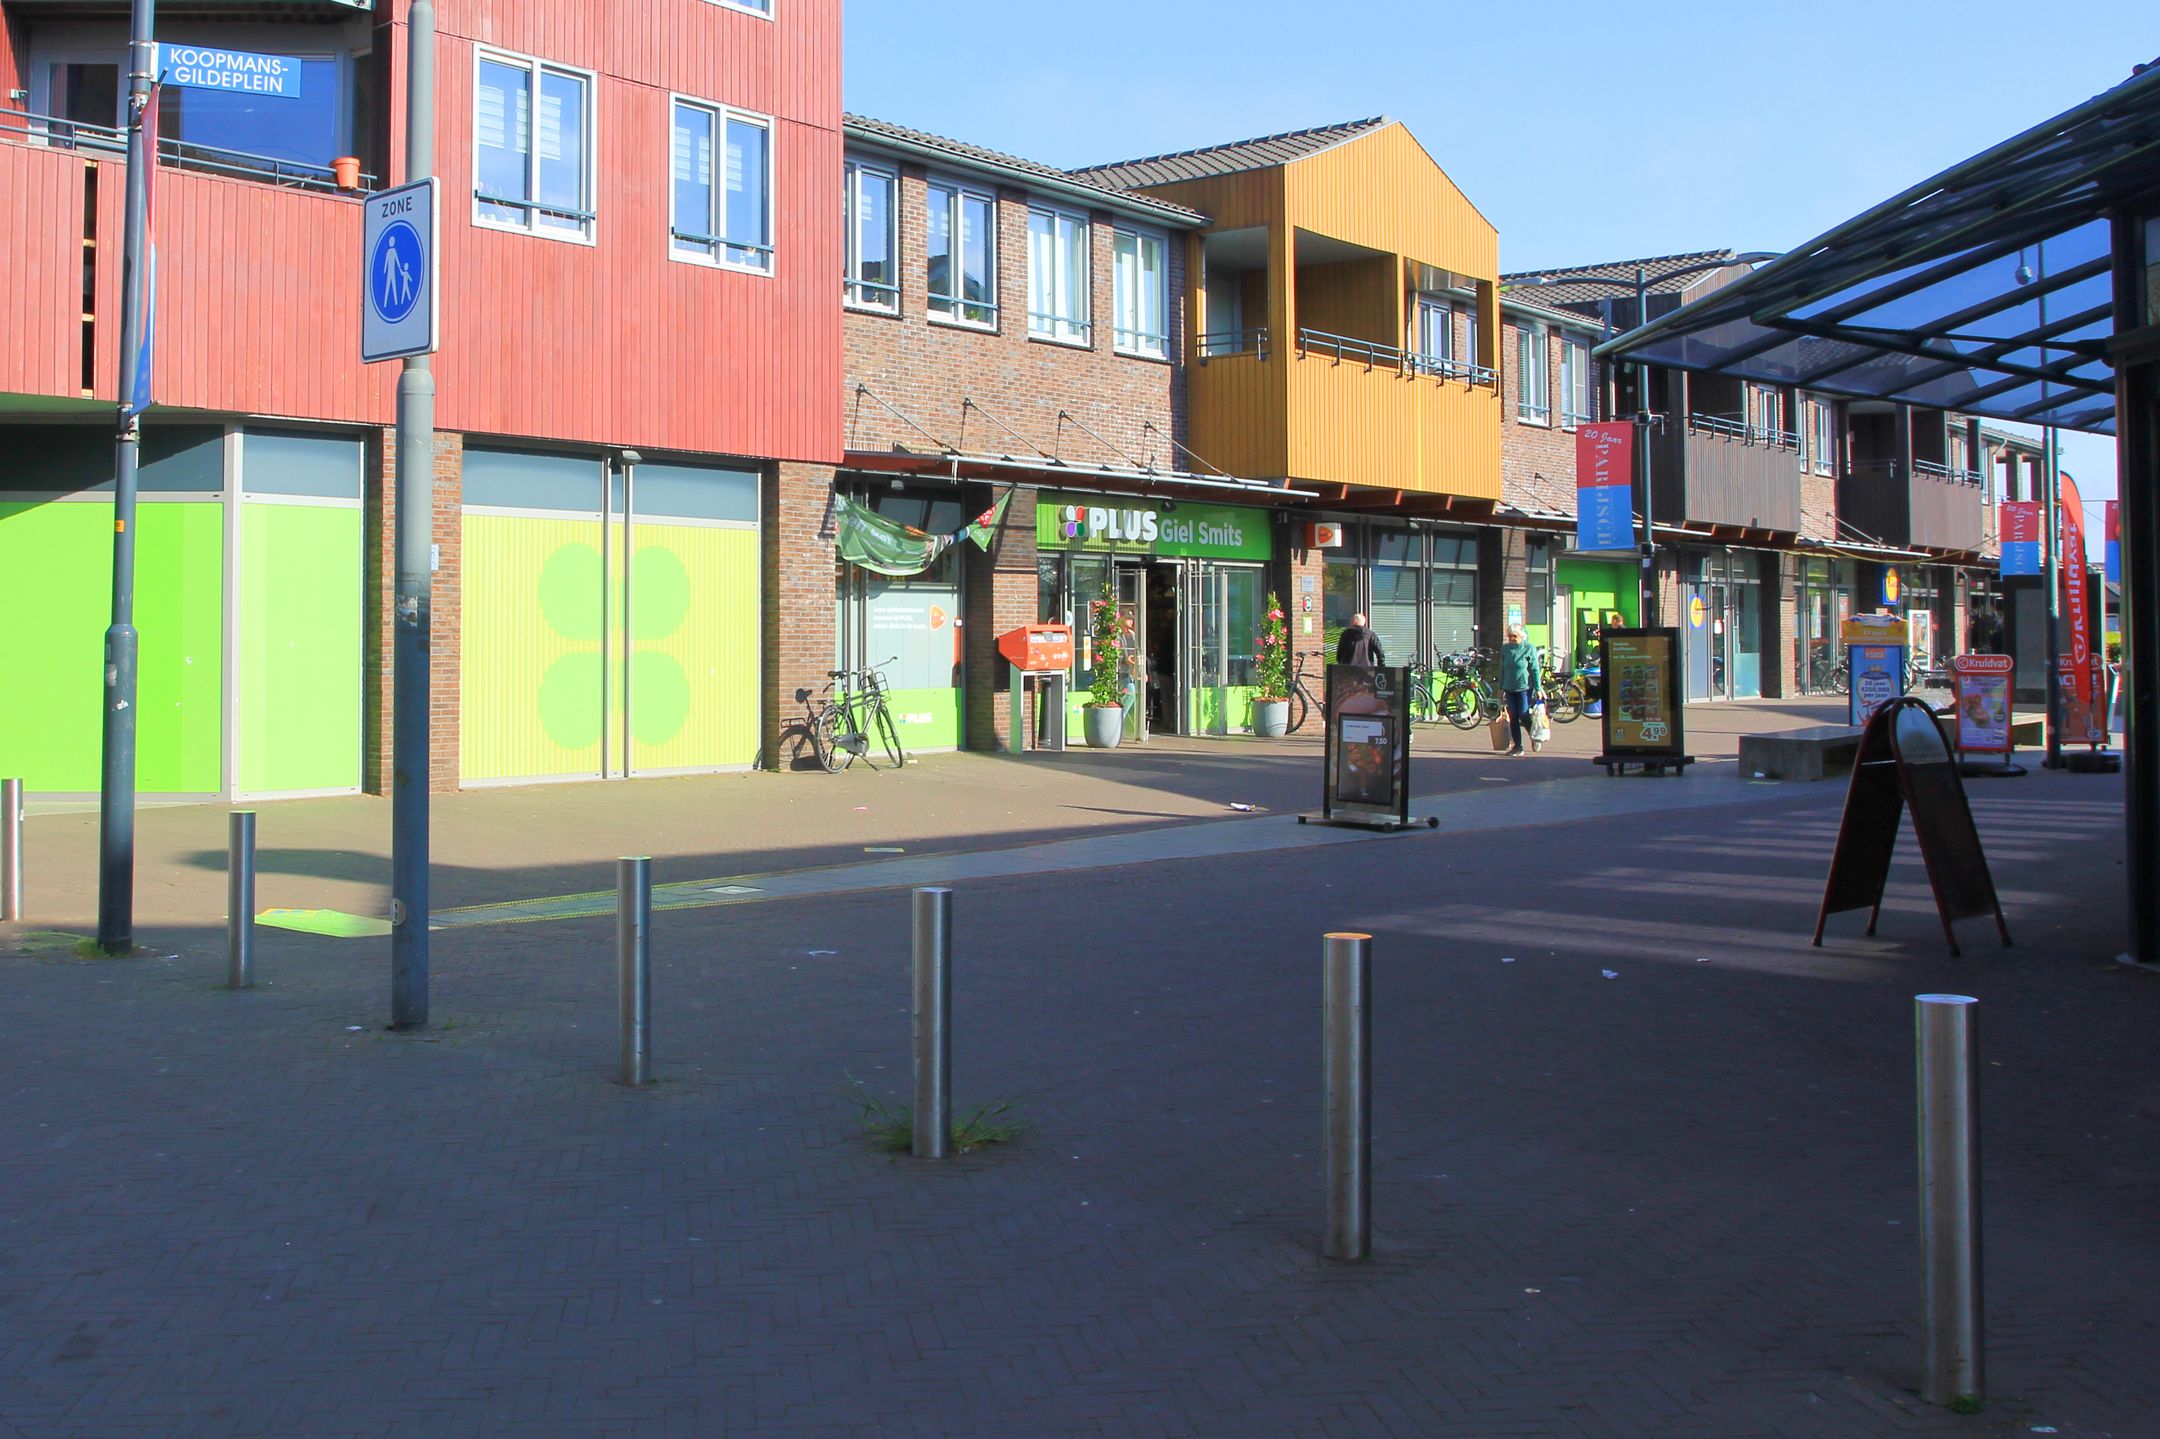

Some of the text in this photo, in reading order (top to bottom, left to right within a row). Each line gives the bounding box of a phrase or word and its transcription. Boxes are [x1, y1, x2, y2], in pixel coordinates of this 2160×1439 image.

[170, 48, 289, 75] KOOPMANS-
[175, 66, 283, 93] GILDEPLEIN
[382, 196, 413, 218] ZONE
[1584, 429, 1623, 444] 20 Jaar
[1088, 506, 1244, 547] PLUS Giel Smits
[1969, 658, 2008, 668] Kruidvat
